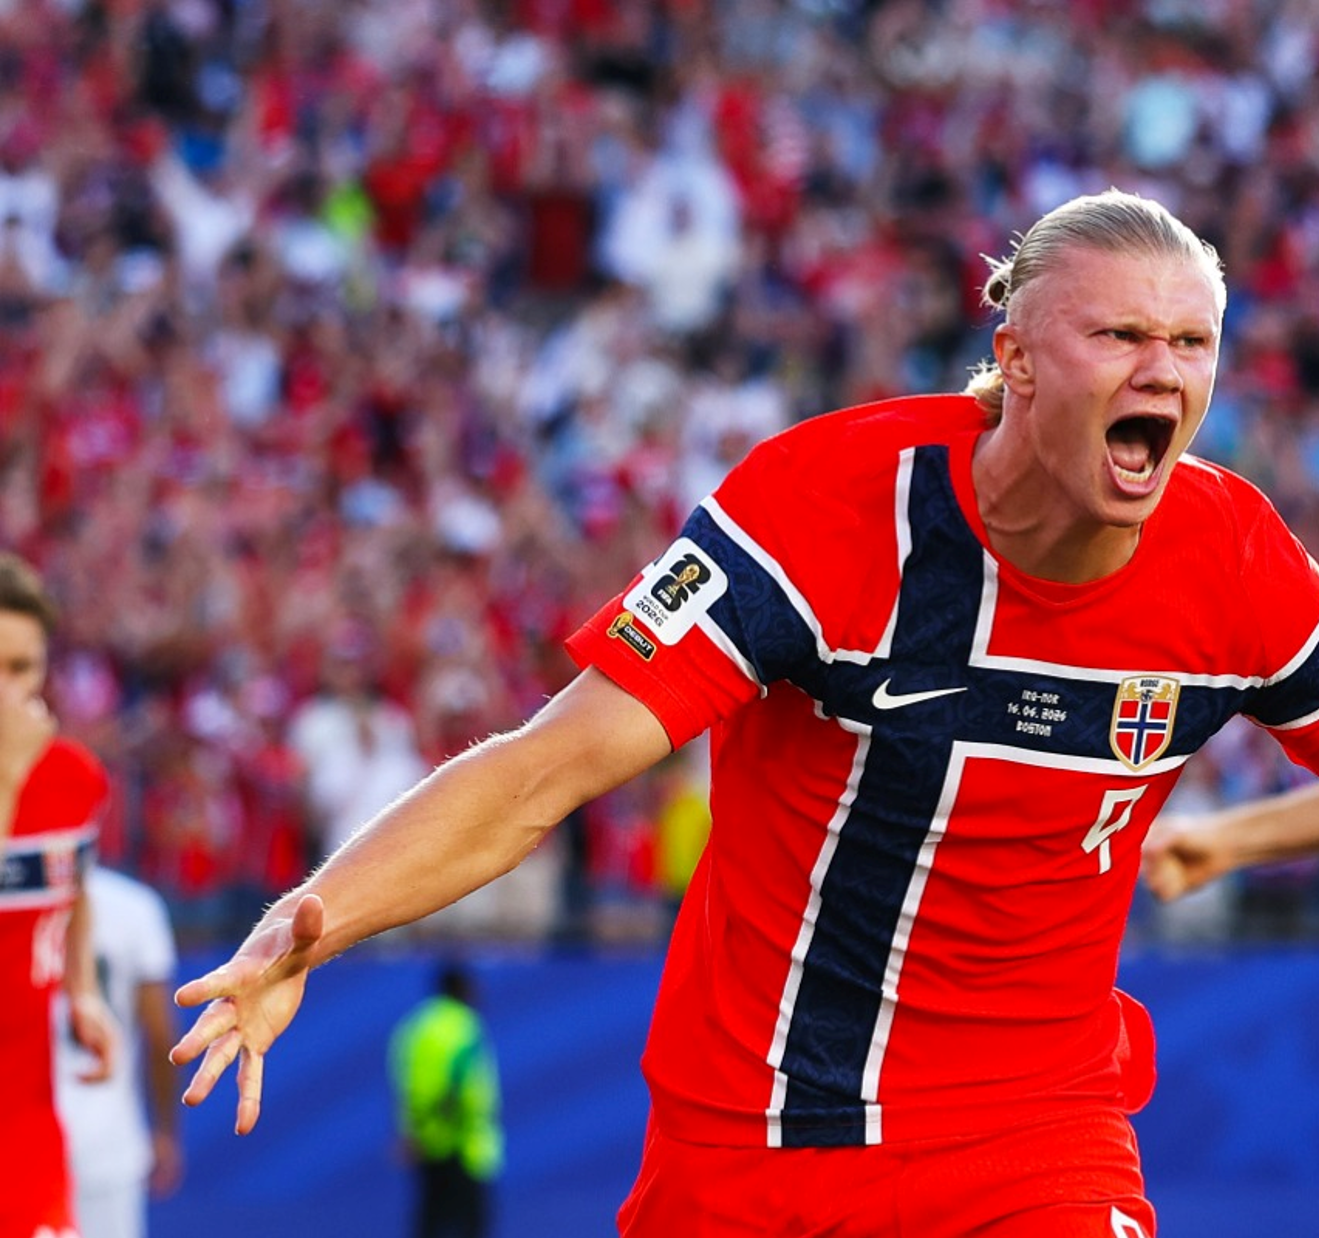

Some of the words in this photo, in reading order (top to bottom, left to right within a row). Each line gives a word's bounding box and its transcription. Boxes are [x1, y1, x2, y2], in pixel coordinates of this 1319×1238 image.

[635, 599, 664, 627] 2026
[624, 626, 653, 651] DEBUT
[1016, 720, 1052, 737] BOSTON
[1081, 783, 1149, 875] 9
